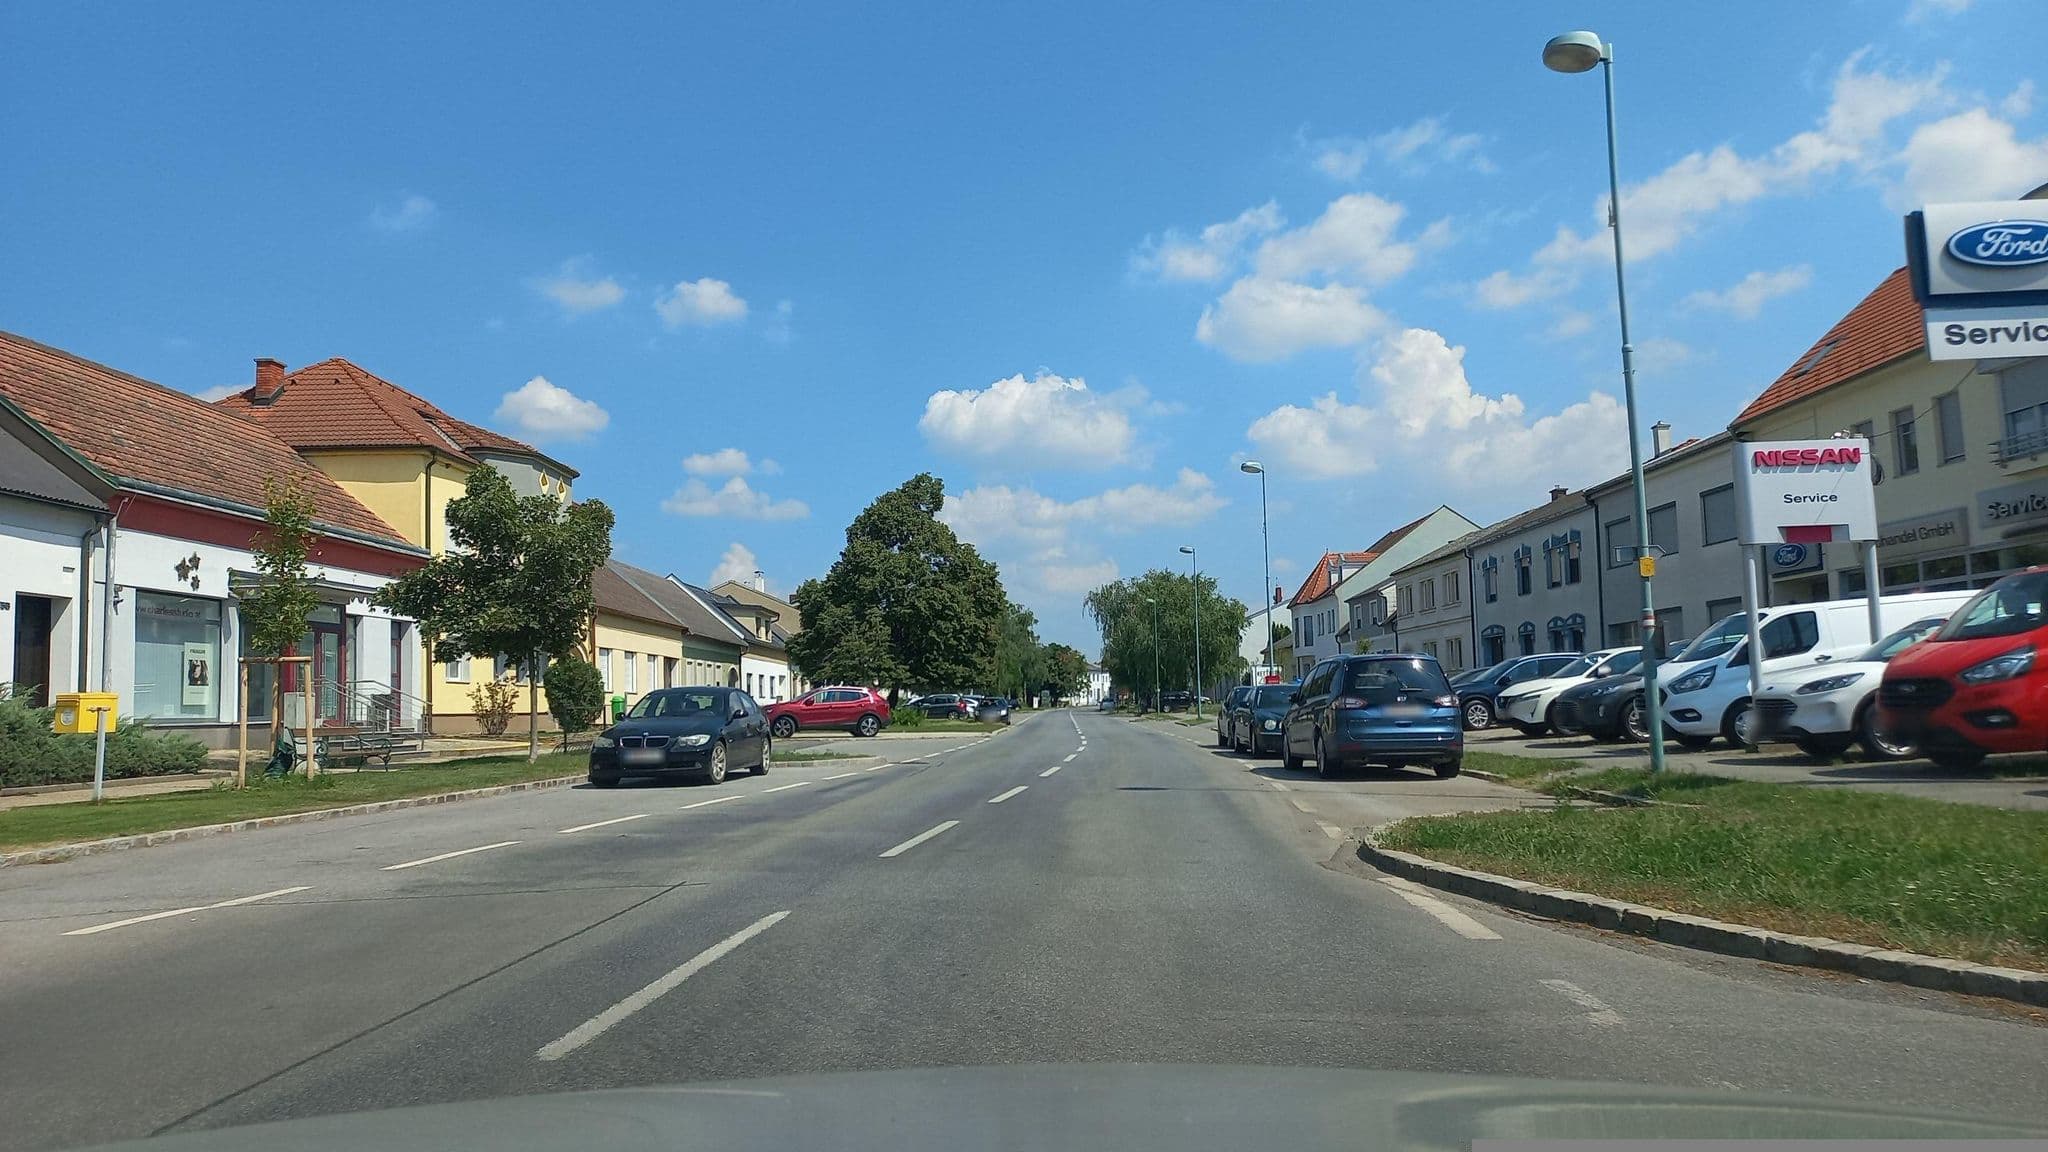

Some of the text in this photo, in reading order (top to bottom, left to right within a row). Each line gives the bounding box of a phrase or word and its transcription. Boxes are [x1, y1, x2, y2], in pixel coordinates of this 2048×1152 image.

[1976, 228, 2048, 257] Ford
[1944, 321, 2048, 345] Servic
[1754, 448, 1861, 467] NISSAN
[1783, 493, 1838, 504] Service
[1918, 521, 1956, 540] GmbH
[1777, 547, 1798, 563] Ford
